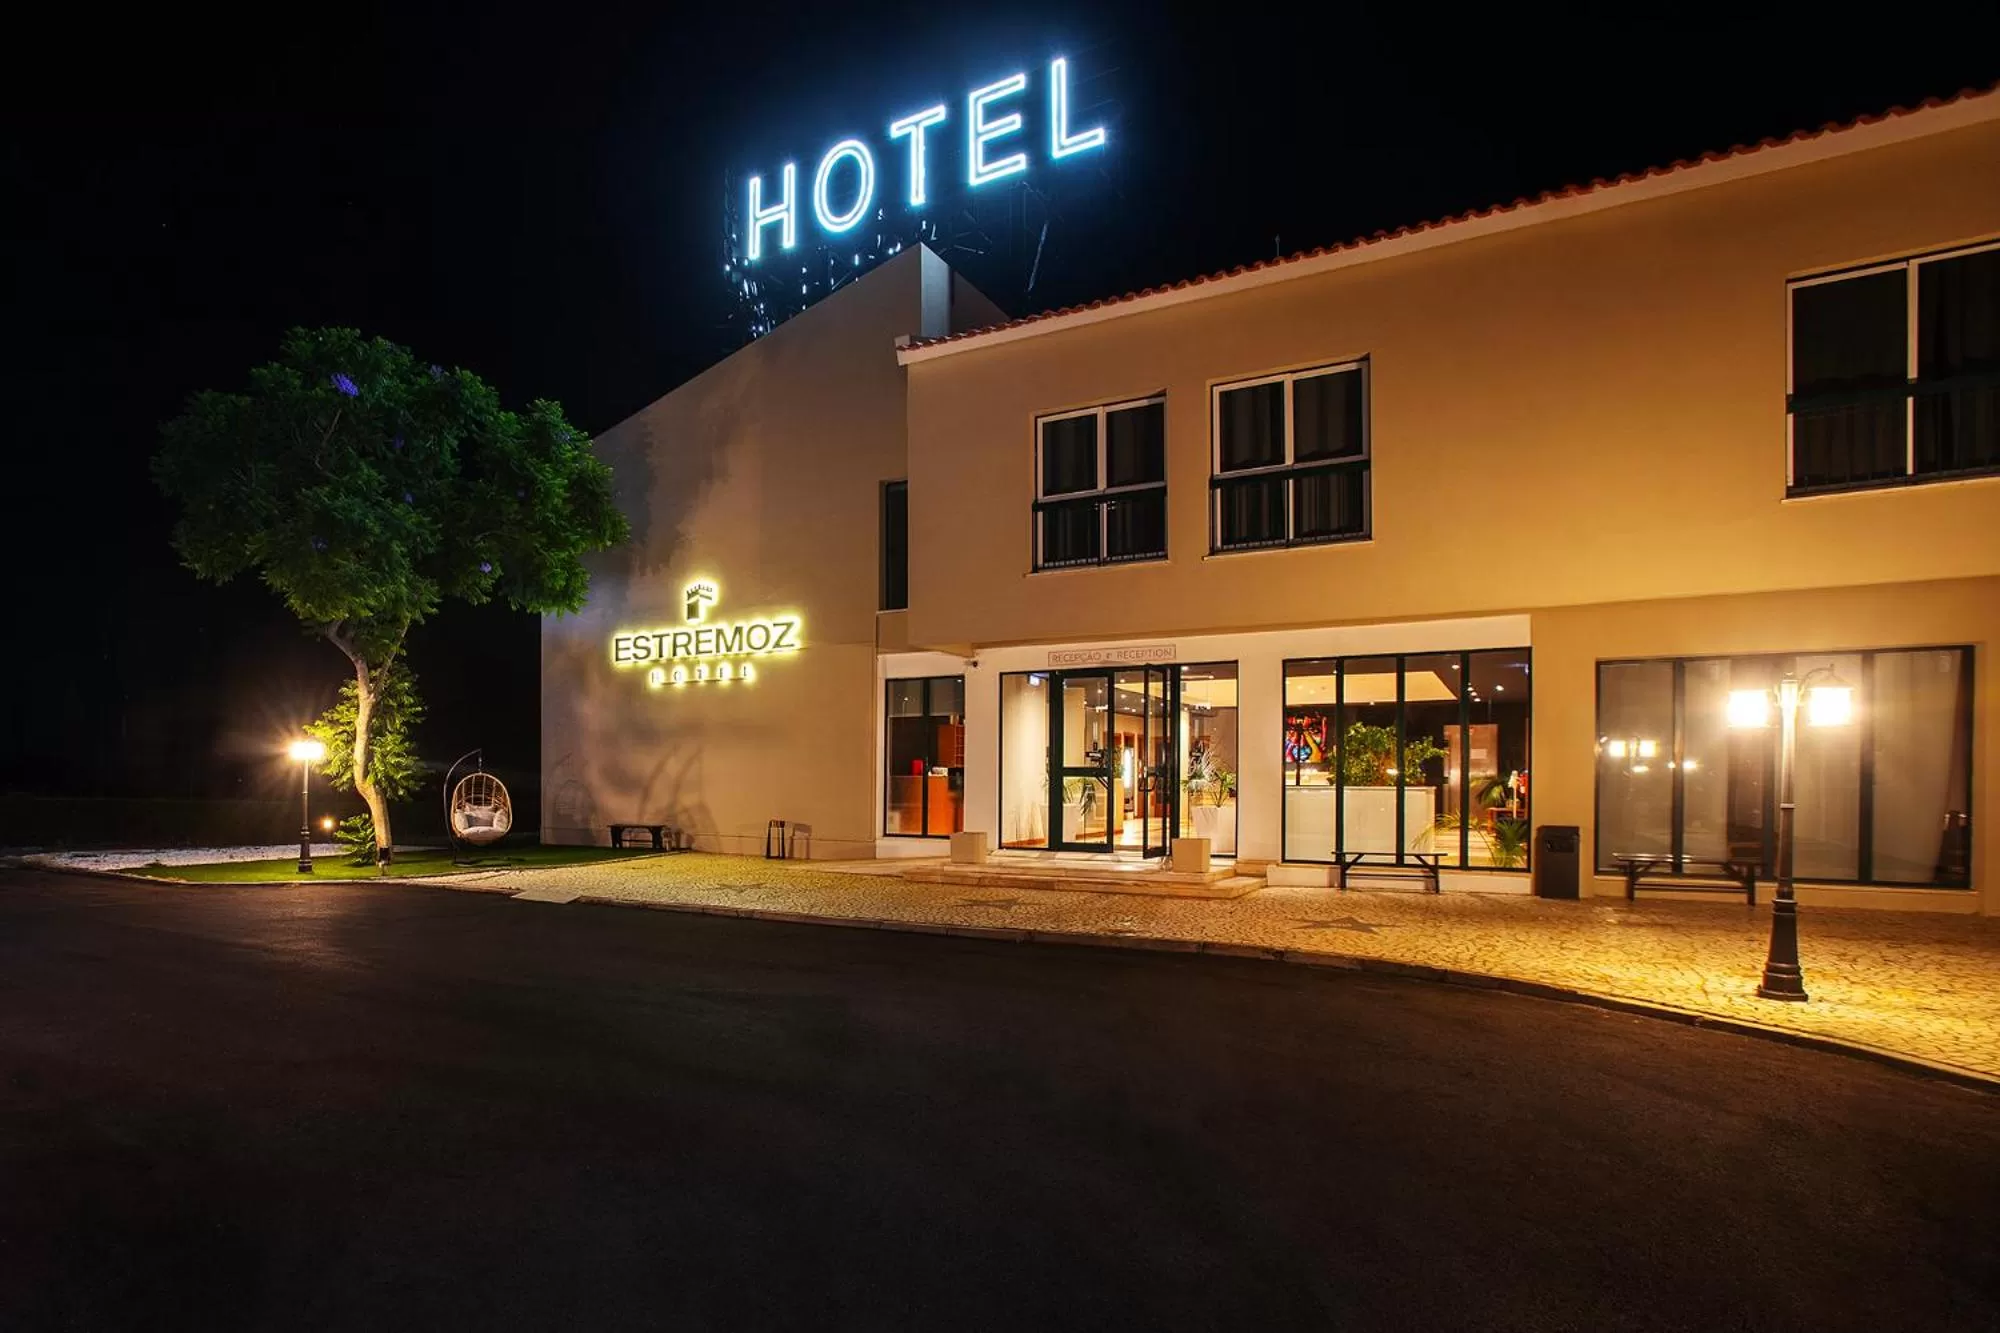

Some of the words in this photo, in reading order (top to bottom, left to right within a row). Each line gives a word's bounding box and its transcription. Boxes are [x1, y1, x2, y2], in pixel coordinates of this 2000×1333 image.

[747, 56, 1106, 261] HOTEL
[614, 621, 796, 662] ESTREMOZ
[1117, 647, 1172, 661] RECEPTION
